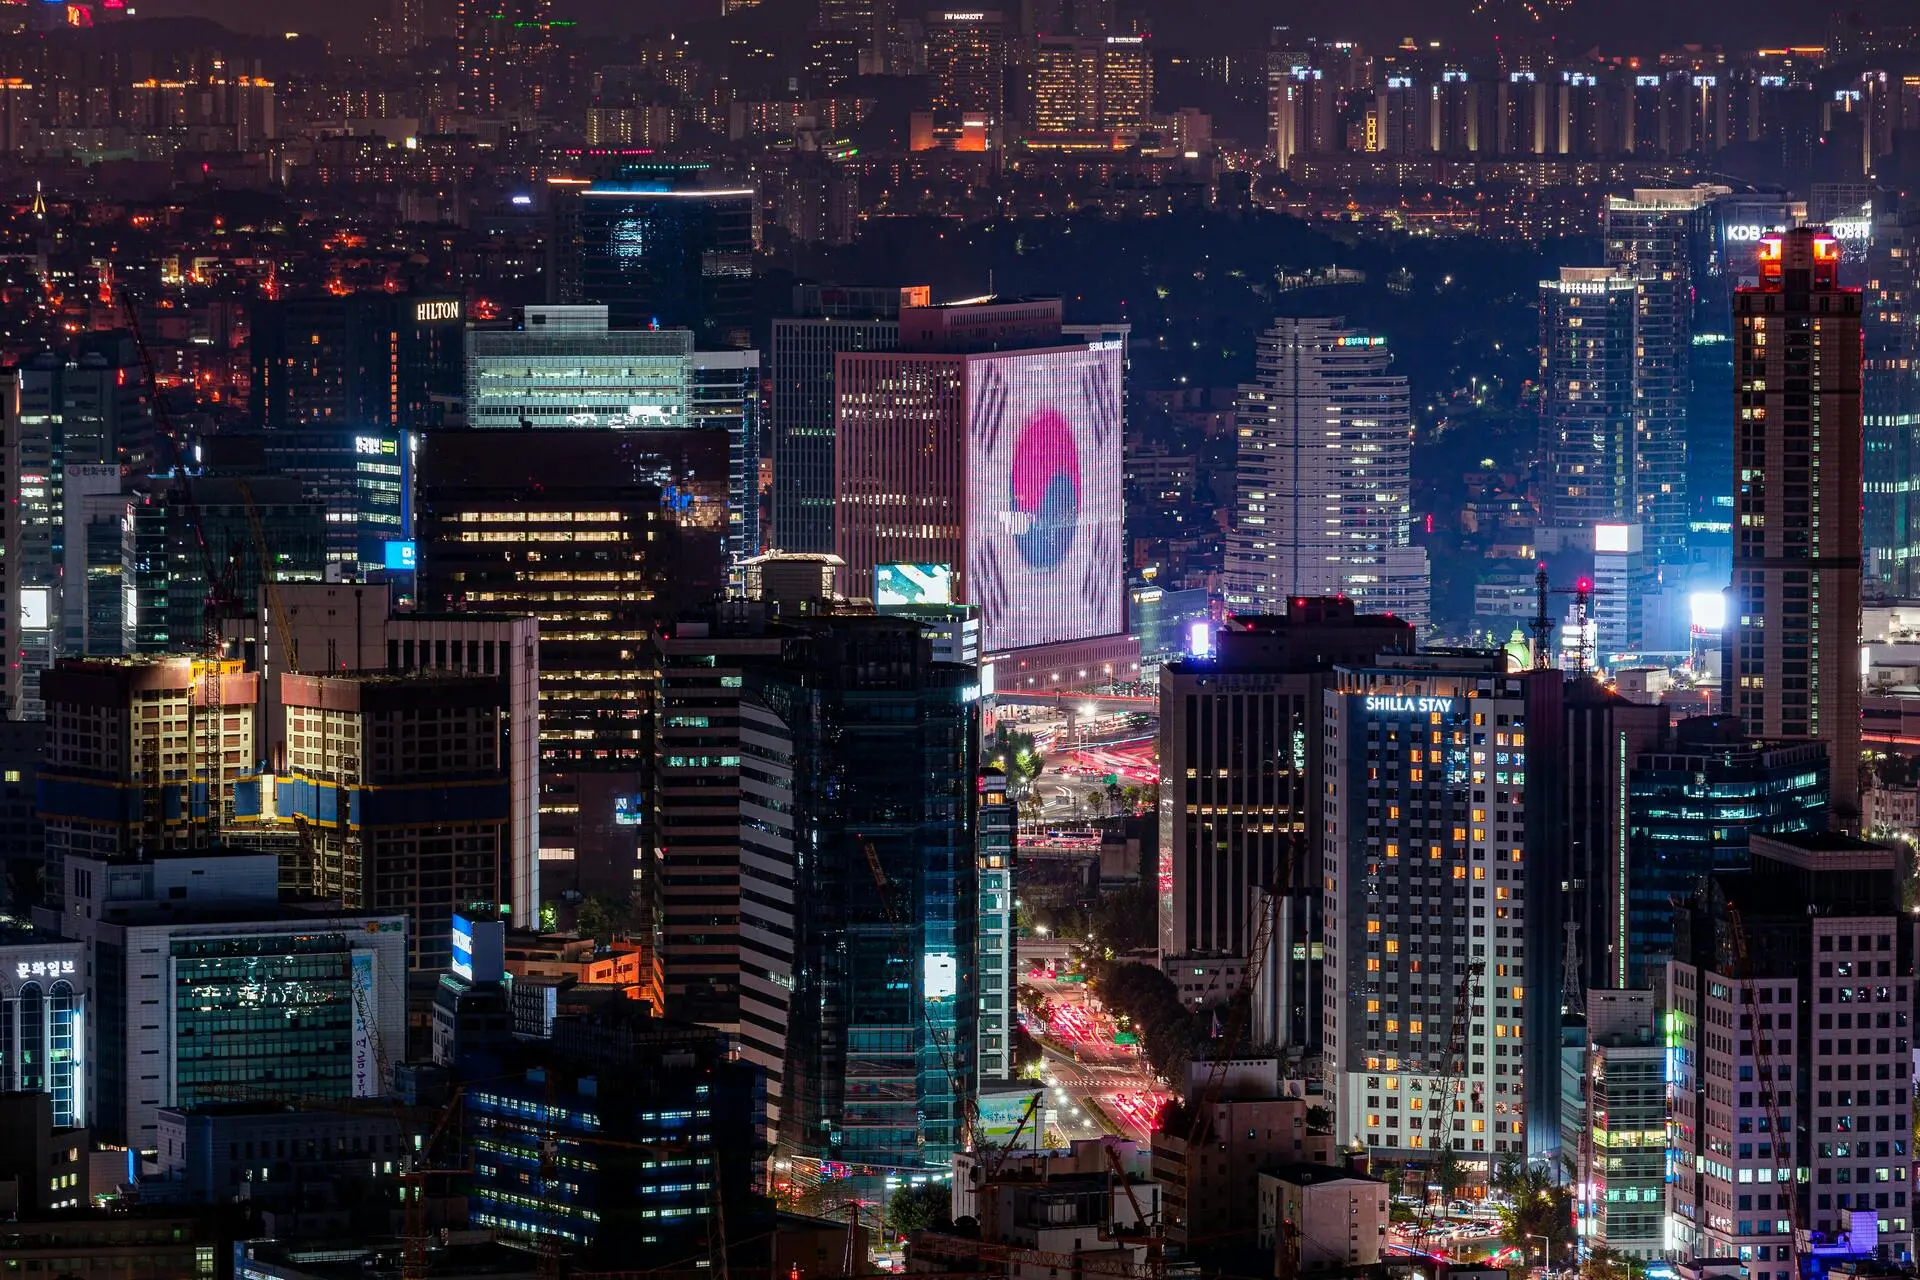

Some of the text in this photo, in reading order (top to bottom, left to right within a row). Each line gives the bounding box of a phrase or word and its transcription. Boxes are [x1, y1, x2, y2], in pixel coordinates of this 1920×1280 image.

[417, 301, 459, 320] HILTON
[1088, 339, 1123, 351] SEOUL SQUARE
[1366, 696, 1453, 712] SHILLA STAY
[16, 960, 75, 979] 문화일보
